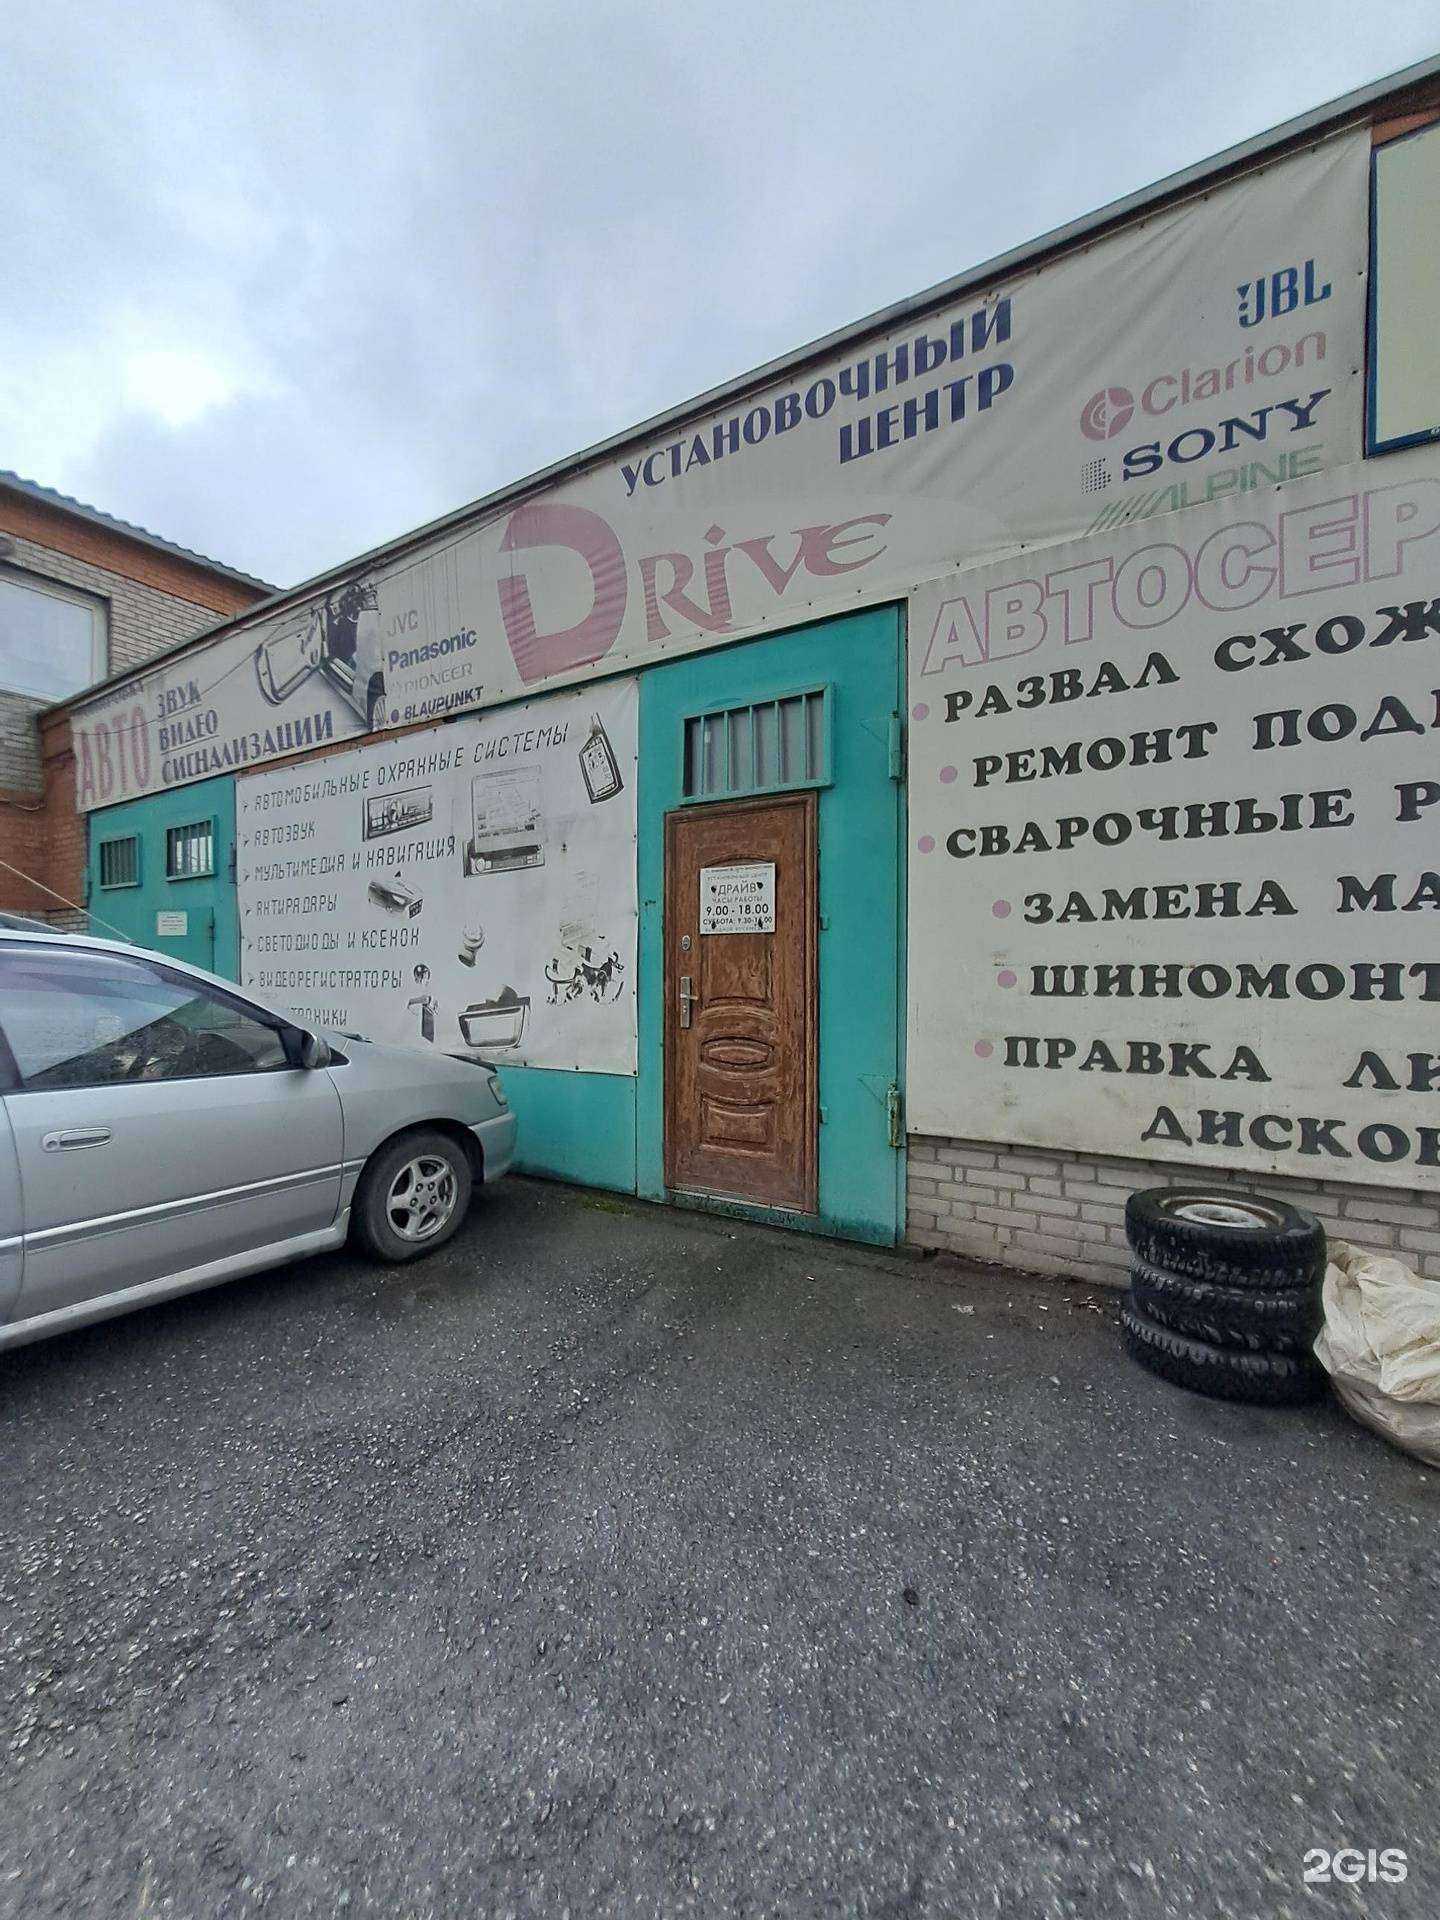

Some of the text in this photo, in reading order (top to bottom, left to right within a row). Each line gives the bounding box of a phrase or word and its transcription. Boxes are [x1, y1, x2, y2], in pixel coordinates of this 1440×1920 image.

[1237, 259, 1331, 328] JBL
[621, 293, 1011, 496] УСТАНОВОЧНЫЙ
[1141, 331, 1327, 415] Clarion
[840, 363, 1016, 464] ЦЕНТР
[1123, 389, 1331, 481] SONY
[1146, 444, 1324, 511] ALPINE
[921, 478, 1440, 677] АВТОСЕР
[386, 609, 418, 637] JVC
[388, 627, 478, 672] Panasonic
[157, 679, 201, 718] ЗВУК
[404, 685, 484, 720] BLAUPUNKT
[944, 652, 1180, 722] РАЗВАЛ
[80, 704, 149, 804] АВТО
[159, 709, 218, 751] ВИДЕО
[161, 710, 333, 784] СИГНАЛИЗАЦИИ
[973, 721, 1218, 787] РЕМОНТ
[254, 723, 569, 812] АВТОМОБИЛЬНЫЕ ОХРАННЫЕ СИСТЕМЫ
[254, 821, 316, 847] АВТОЗВУК
[945, 788, 1355, 859] СВАРОЧНЫЕ
[254, 836, 455, 882] МУЛЬТИМЕДИЯ И НАВИГАЦИЯ
[256, 894, 338, 916] АНТИРАДАРЫ
[718, 880, 756, 896] ДРАЙВ
[739, 903, 769, 915] 18.00
[1023, 872, 1440, 924] ЗАМЕНА МА
[257, 927, 420, 952] СВЕТОДИОДЫ И КСЕНОН
[259, 969, 402, 989] ВИДЕОРЕГИСТРАТОРЫ
[1003, 1036, 1272, 1082] ПРАВКА
